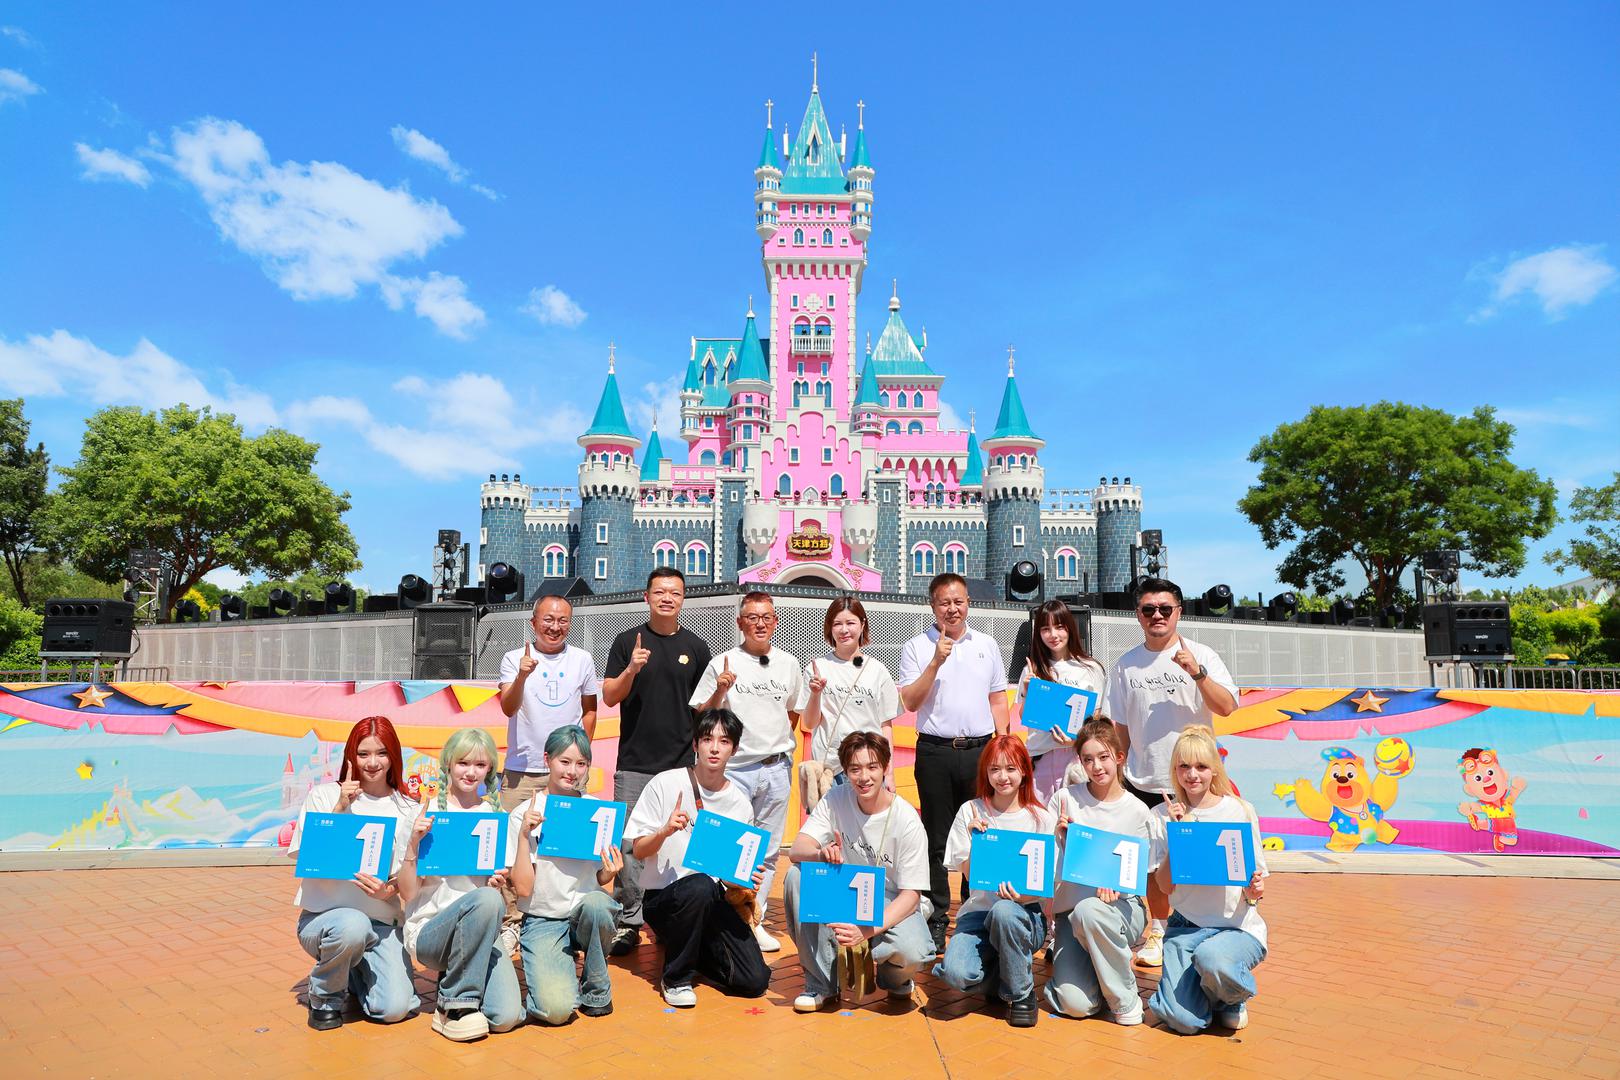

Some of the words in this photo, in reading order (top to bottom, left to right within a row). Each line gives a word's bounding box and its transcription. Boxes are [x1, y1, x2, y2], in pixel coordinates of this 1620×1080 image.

[545, 680, 558, 700] 1
[1066, 694, 1089, 736] 1
[356, 822, 386, 876] 1
[470, 819, 499, 870] 1
[590, 807, 616, 856] 1
[1216, 830, 1247, 882] 1
[736, 832, 762, 882] 1
[1018, 839, 1046, 892] 1
[1112, 840, 1140, 890] 1
[848, 872, 876, 922] 1
